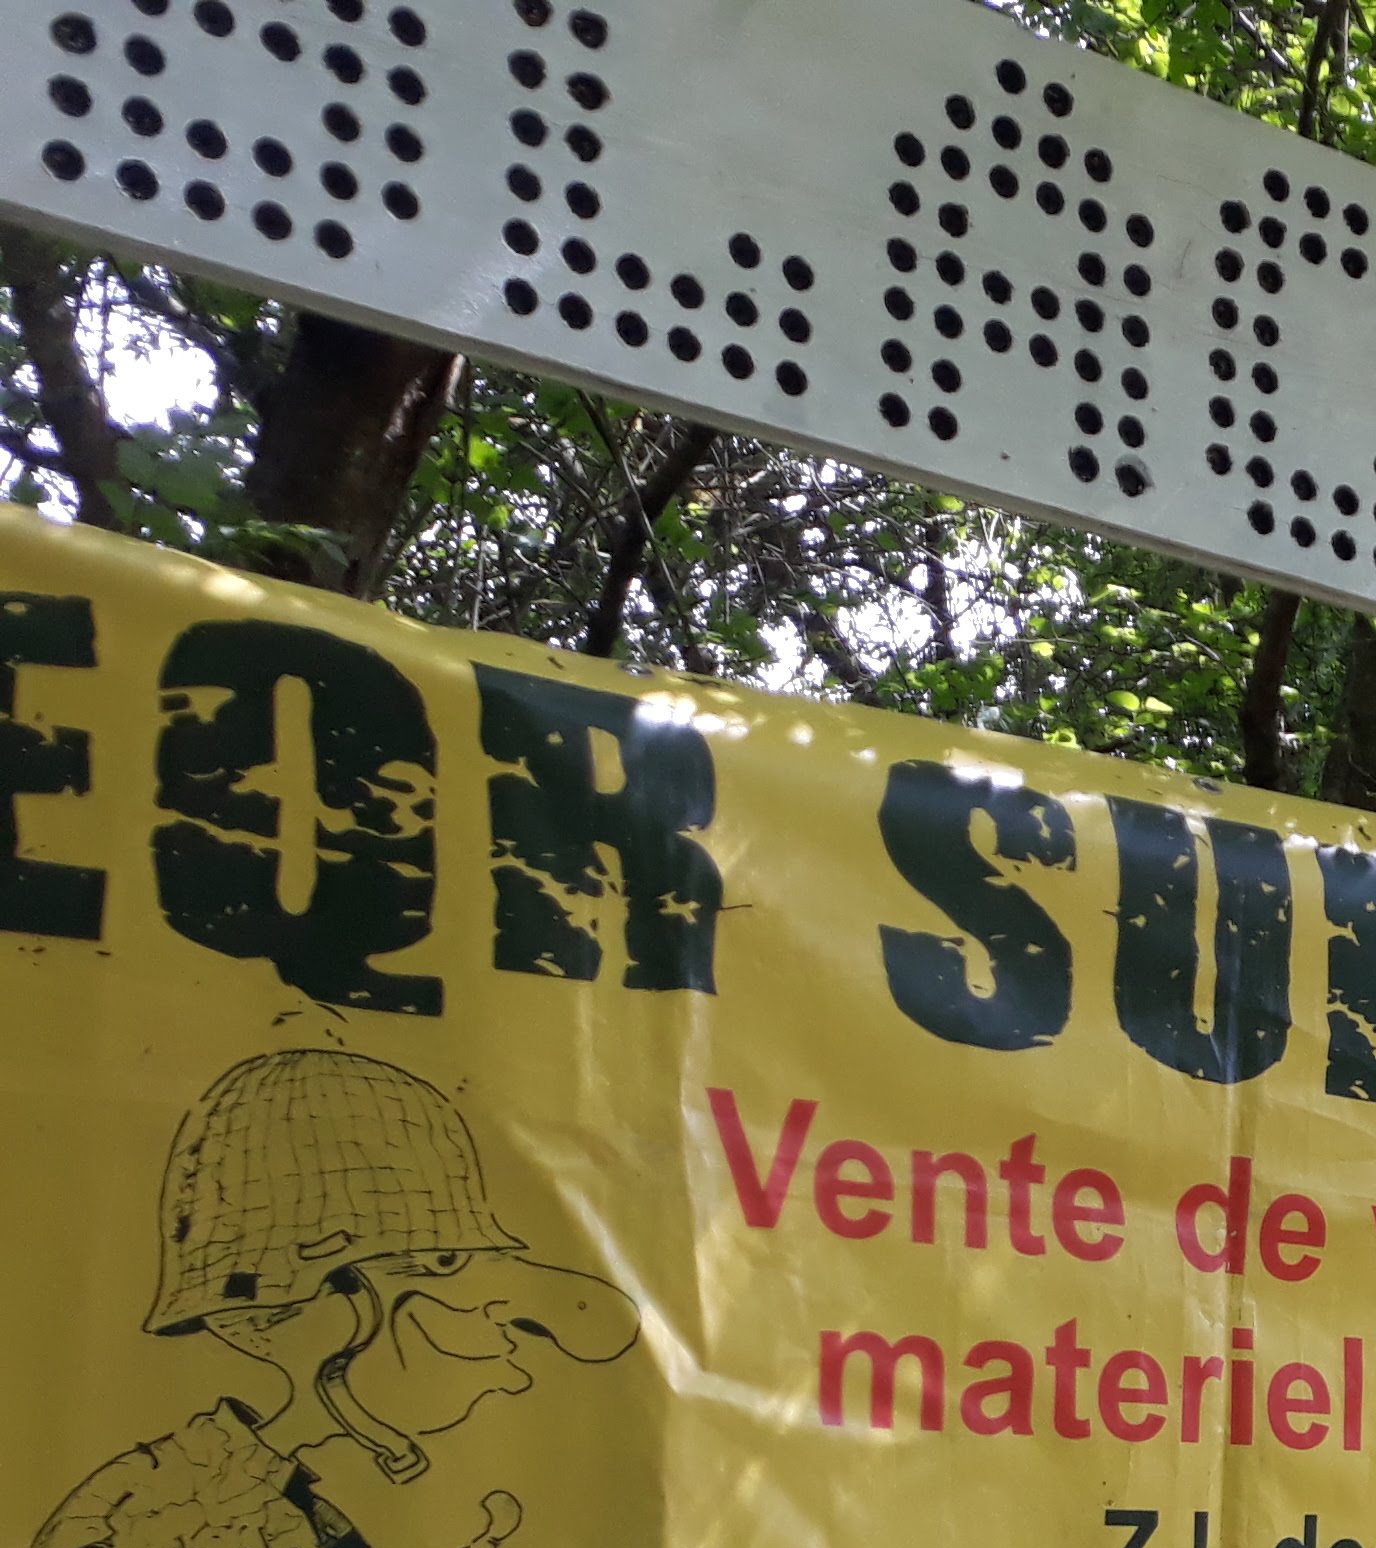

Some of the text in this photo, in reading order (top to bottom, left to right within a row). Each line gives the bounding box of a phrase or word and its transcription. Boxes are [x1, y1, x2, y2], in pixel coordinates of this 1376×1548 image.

[709, 1089, 1124, 1261] Vente
[1176, 1158, 1327, 1281] de
[820, 1320, 1363, 1450] materiel
